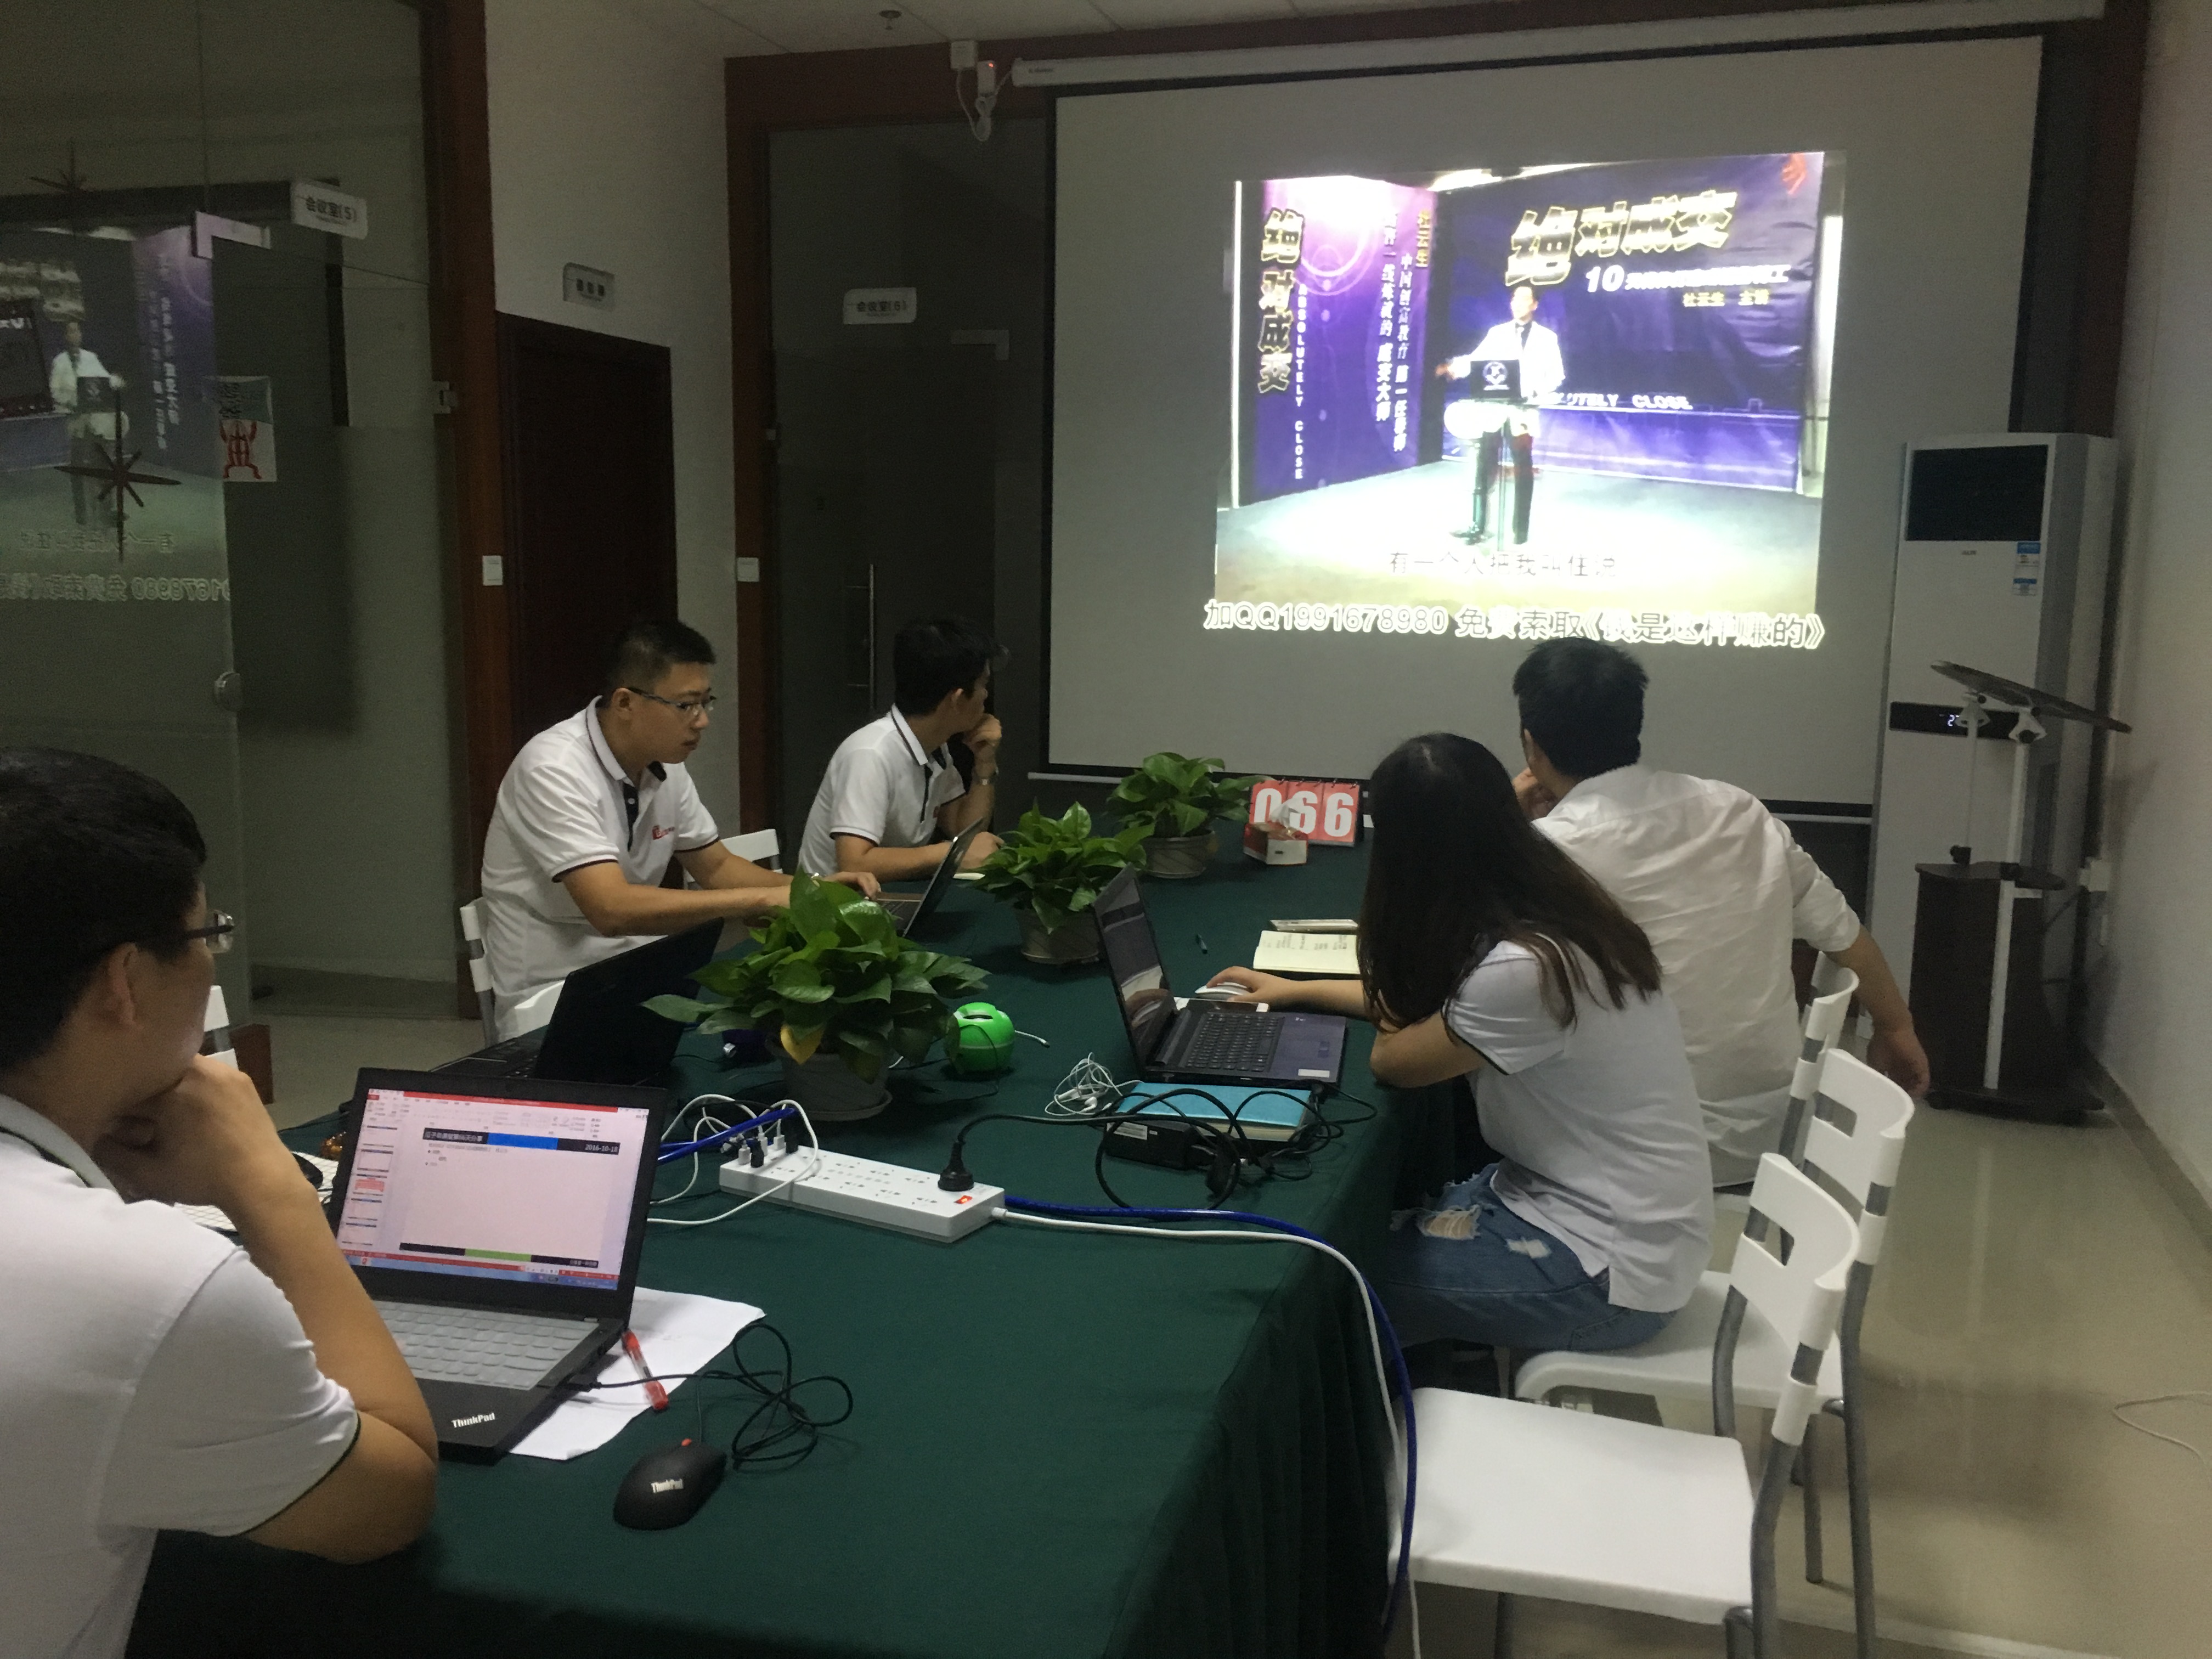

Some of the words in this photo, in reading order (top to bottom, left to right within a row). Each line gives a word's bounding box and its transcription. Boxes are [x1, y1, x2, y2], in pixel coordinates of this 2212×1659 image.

[1632, 394, 1693, 410] CLOSE
[1295, 420, 1305, 479] CLOSE
[1204, 599, 1448, 635] 加QQ1991678980
[585, 1143, 618, 1153] 2016-10-18
[452, 1412, 495, 1429] ThinkPad
